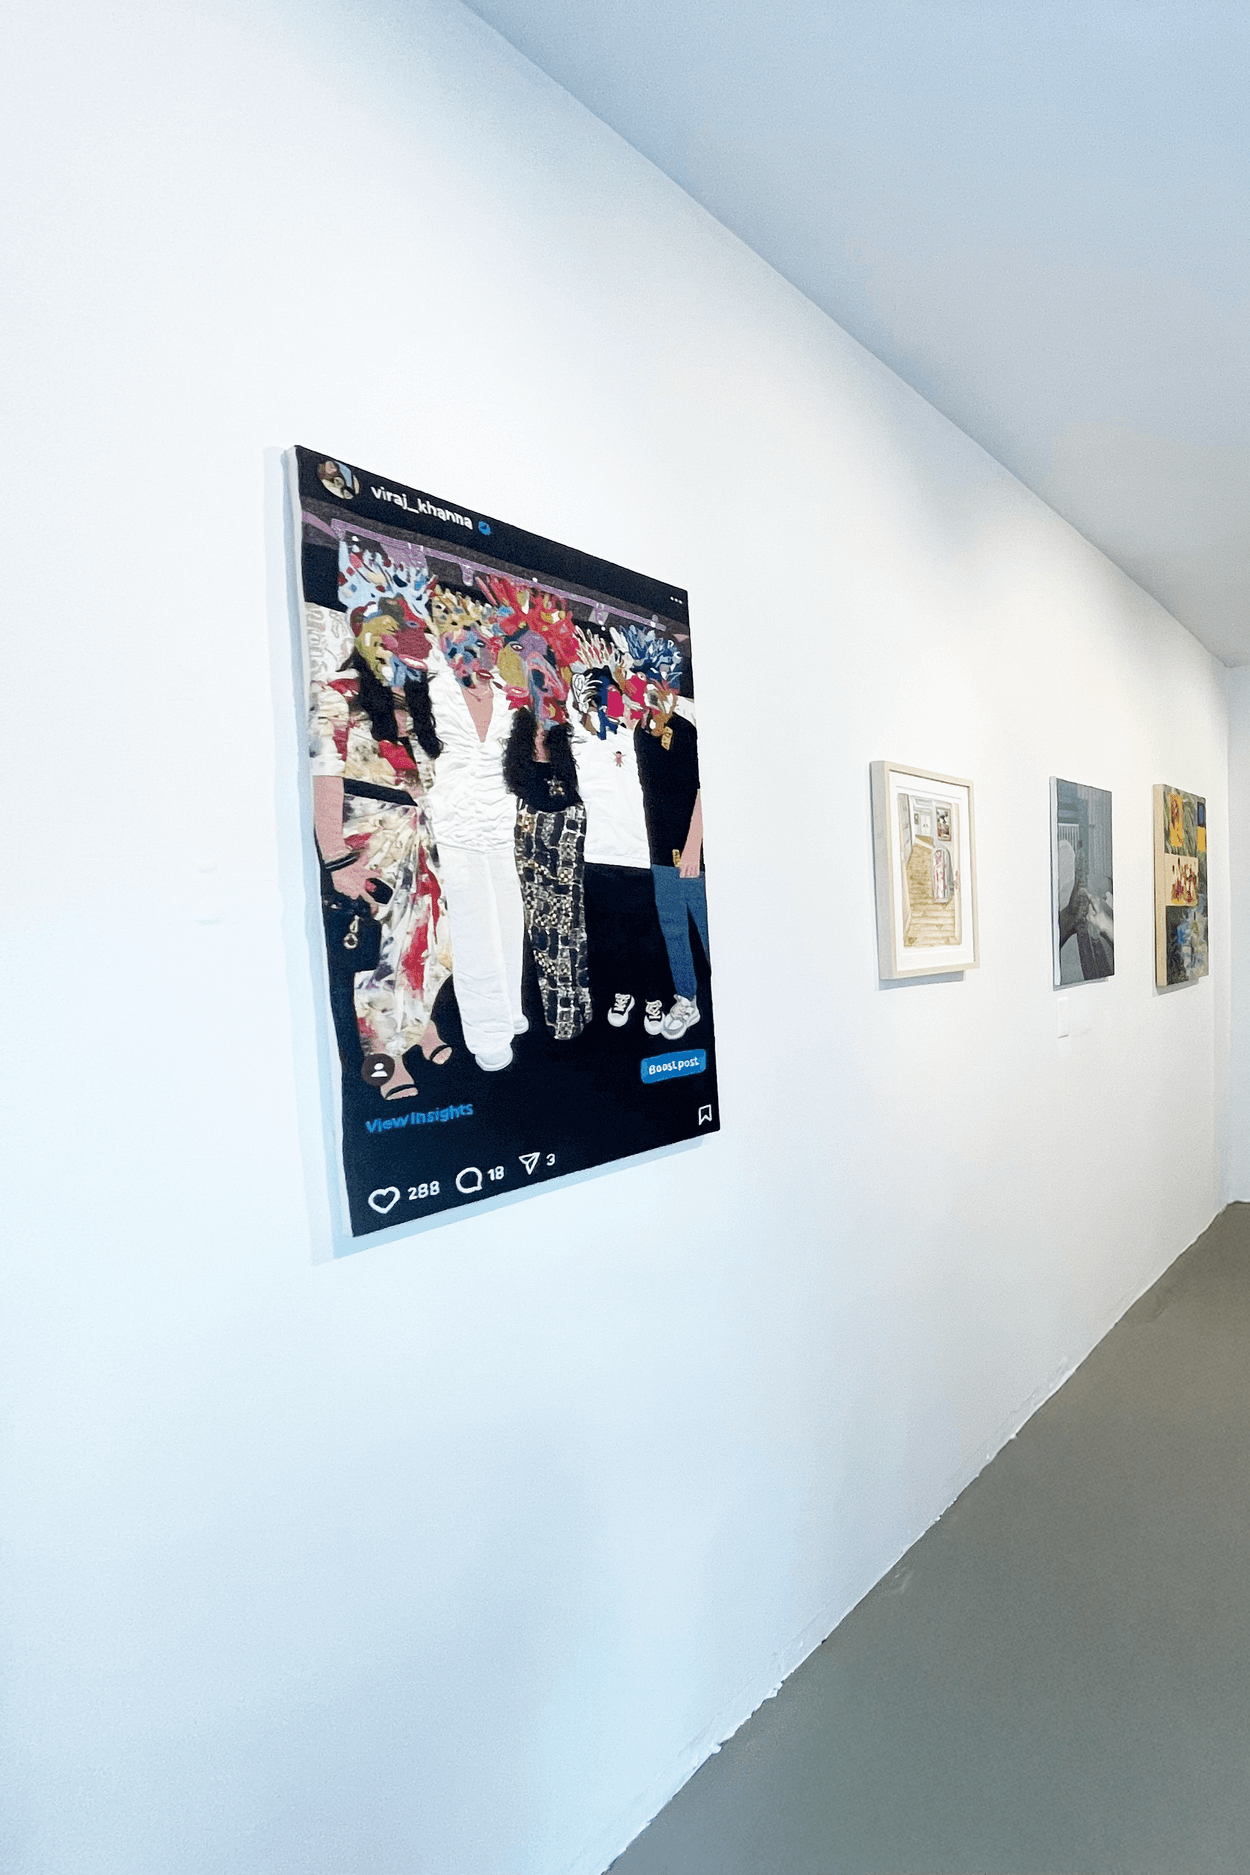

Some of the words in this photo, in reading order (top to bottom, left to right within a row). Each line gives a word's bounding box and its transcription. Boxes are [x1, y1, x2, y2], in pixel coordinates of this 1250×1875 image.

[370, 486, 474, 530] viraj_khanna
[648, 1060, 678, 1075] Boost
[678, 1056, 700, 1071] post
[365, 1114, 410, 1133] View
[410, 1103, 474, 1124] Insights
[546, 1153, 556, 1166] 3
[487, 1165, 505, 1181] 18
[407, 1181, 440, 1201] 288
